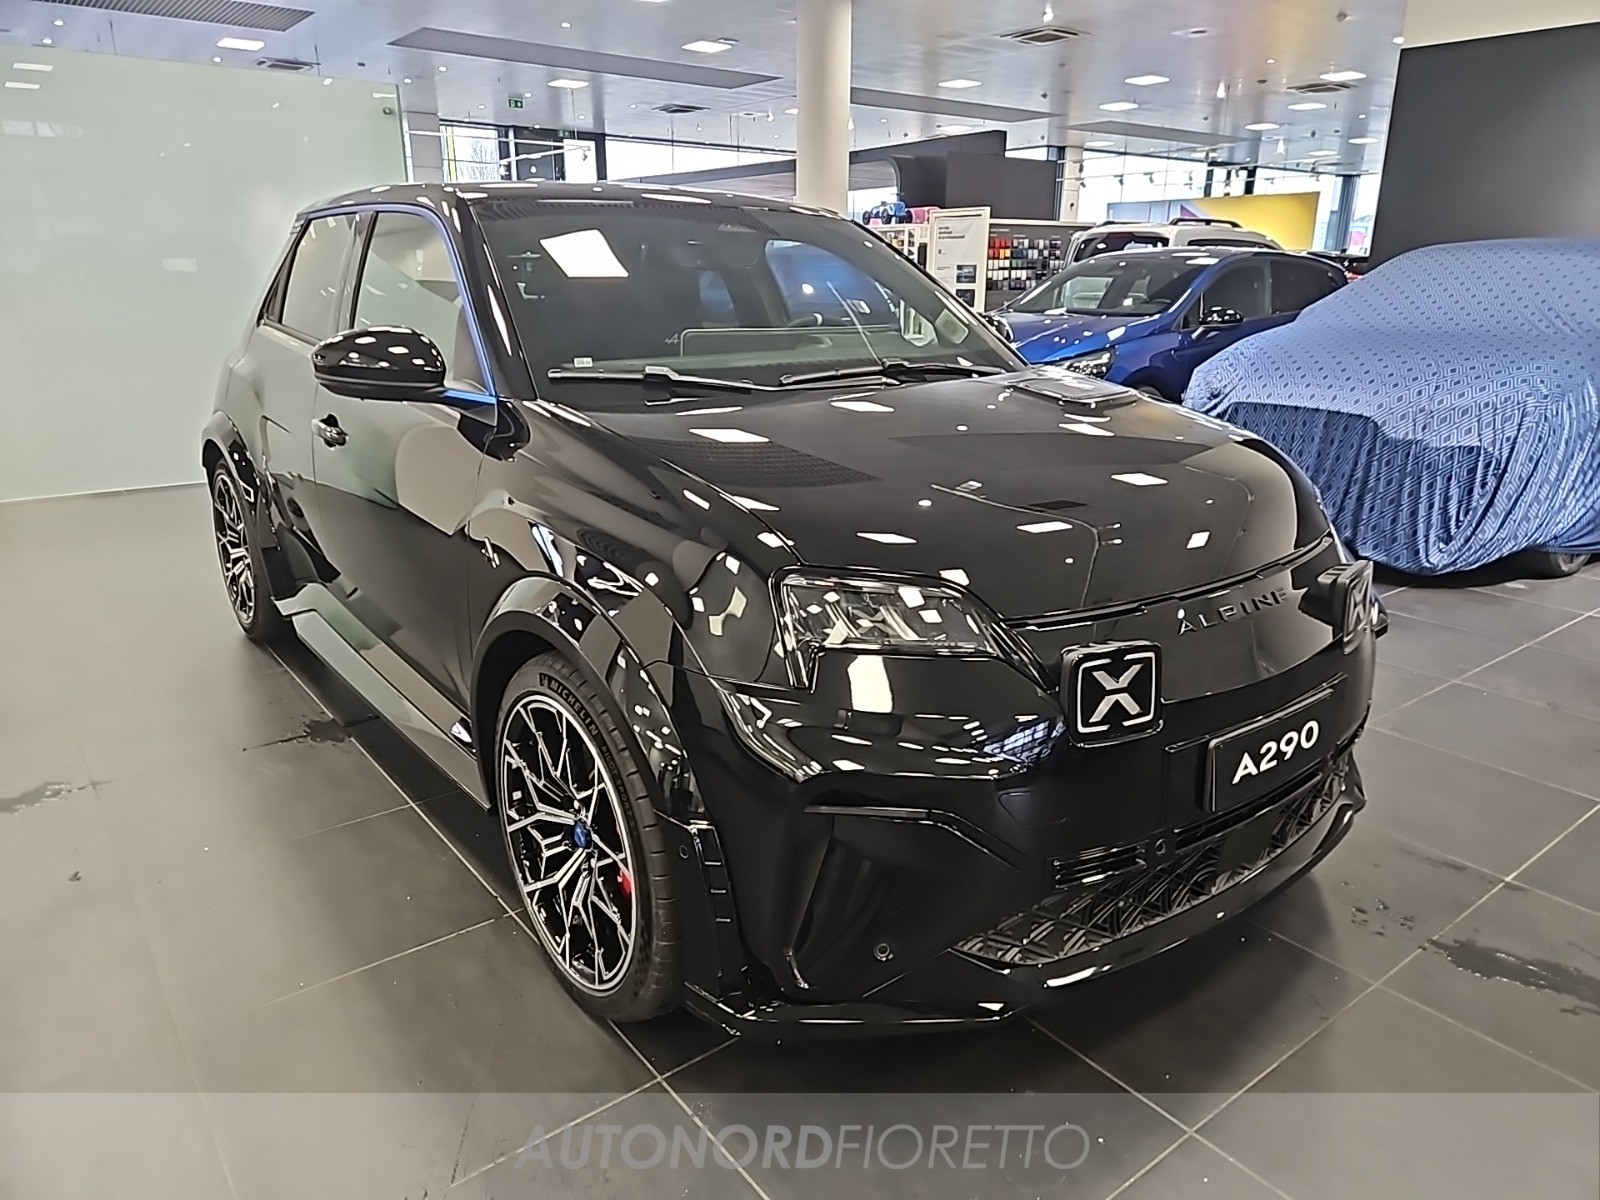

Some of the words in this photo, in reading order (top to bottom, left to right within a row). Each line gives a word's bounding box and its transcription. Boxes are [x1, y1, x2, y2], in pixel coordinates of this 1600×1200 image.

[1177, 588, 1288, 636] ALPINE
[549, 680, 599, 736] MICHELIN
[1231, 720, 1320, 785] A290
